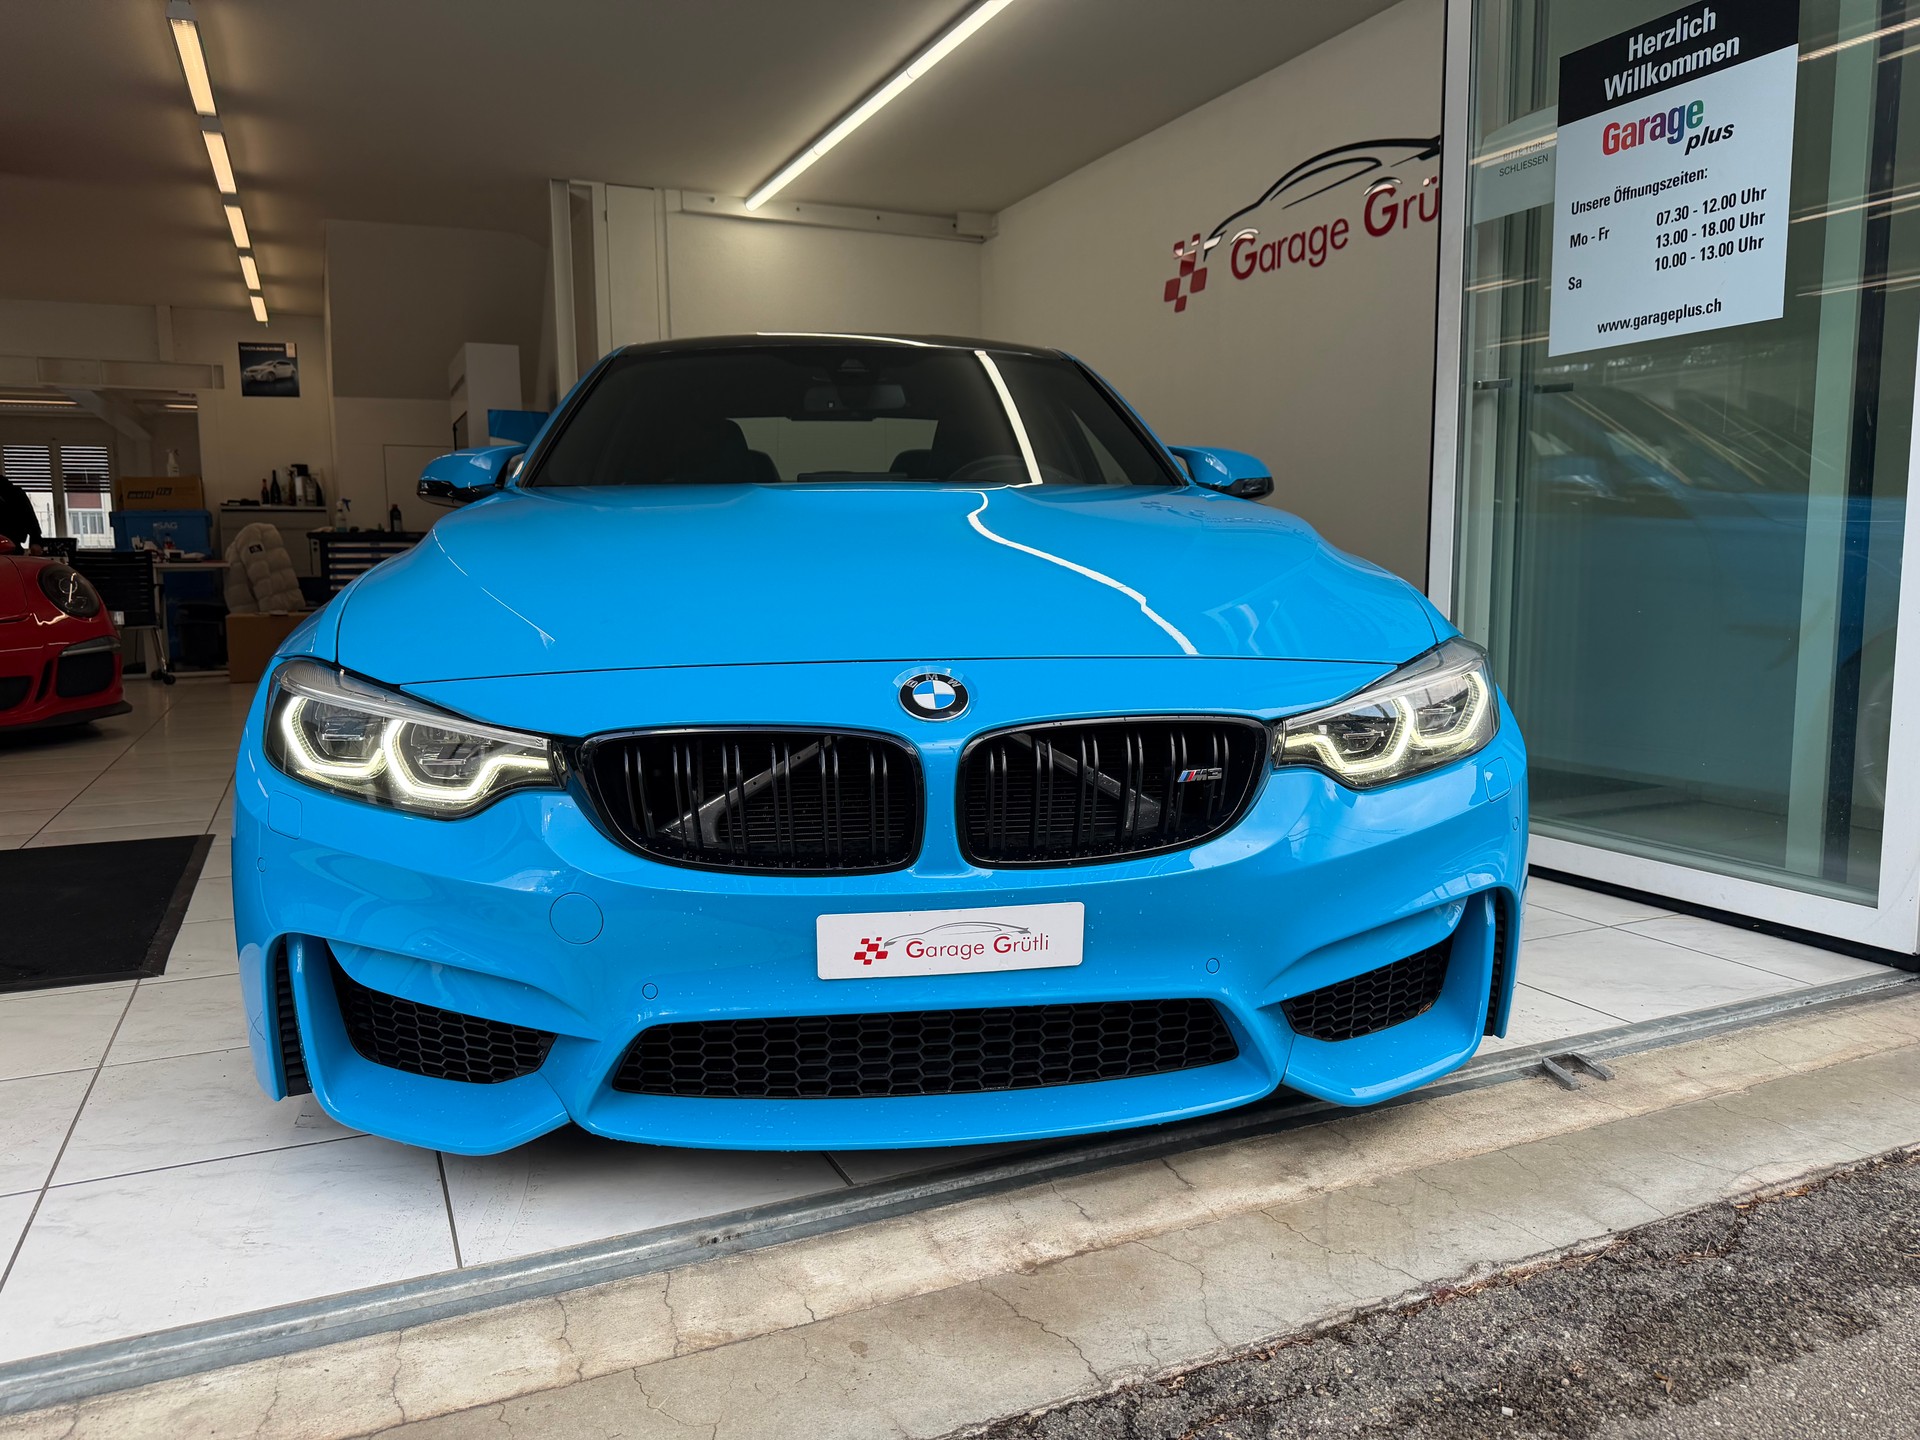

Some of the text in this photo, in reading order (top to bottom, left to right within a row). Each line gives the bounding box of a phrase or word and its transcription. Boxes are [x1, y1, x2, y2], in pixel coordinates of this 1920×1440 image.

[1628, 6, 1717, 62] Herzlich
[1603, 36, 1740, 101] Willkommen
[1602, 99, 1704, 156] Garage
[1684, 123, 1735, 156] plus
[1499, 154, 1549, 177] SCHLIESSEN
[1571, 167, 1708, 216] Unsere Öffnungszeiten:
[1231, 176, 1439, 280] Garage Grü
[1570, 232, 1588, 248] Mo
[1598, 227, 1610, 242] Fr
[1656, 205, 1689, 226] 07.30
[1702, 192, 1737, 215] 12.00
[1741, 187, 1767, 205] Uhr
[1655, 228, 1688, 249] 13.00
[1701, 216, 1736, 238] 18.00
[1739, 211, 1766, 229] Uhr
[1568, 276, 1582, 291] Sa
[1654, 251, 1687, 271] 10.00
[1700, 240, 1734, 261] 13.00
[1738, 235, 1764, 253] Uhr
[1597, 298, 1722, 334] www.garageplus.ch
[904, 674, 961, 688] BMW
[906, 932, 1049, 960] Garage Grütli
